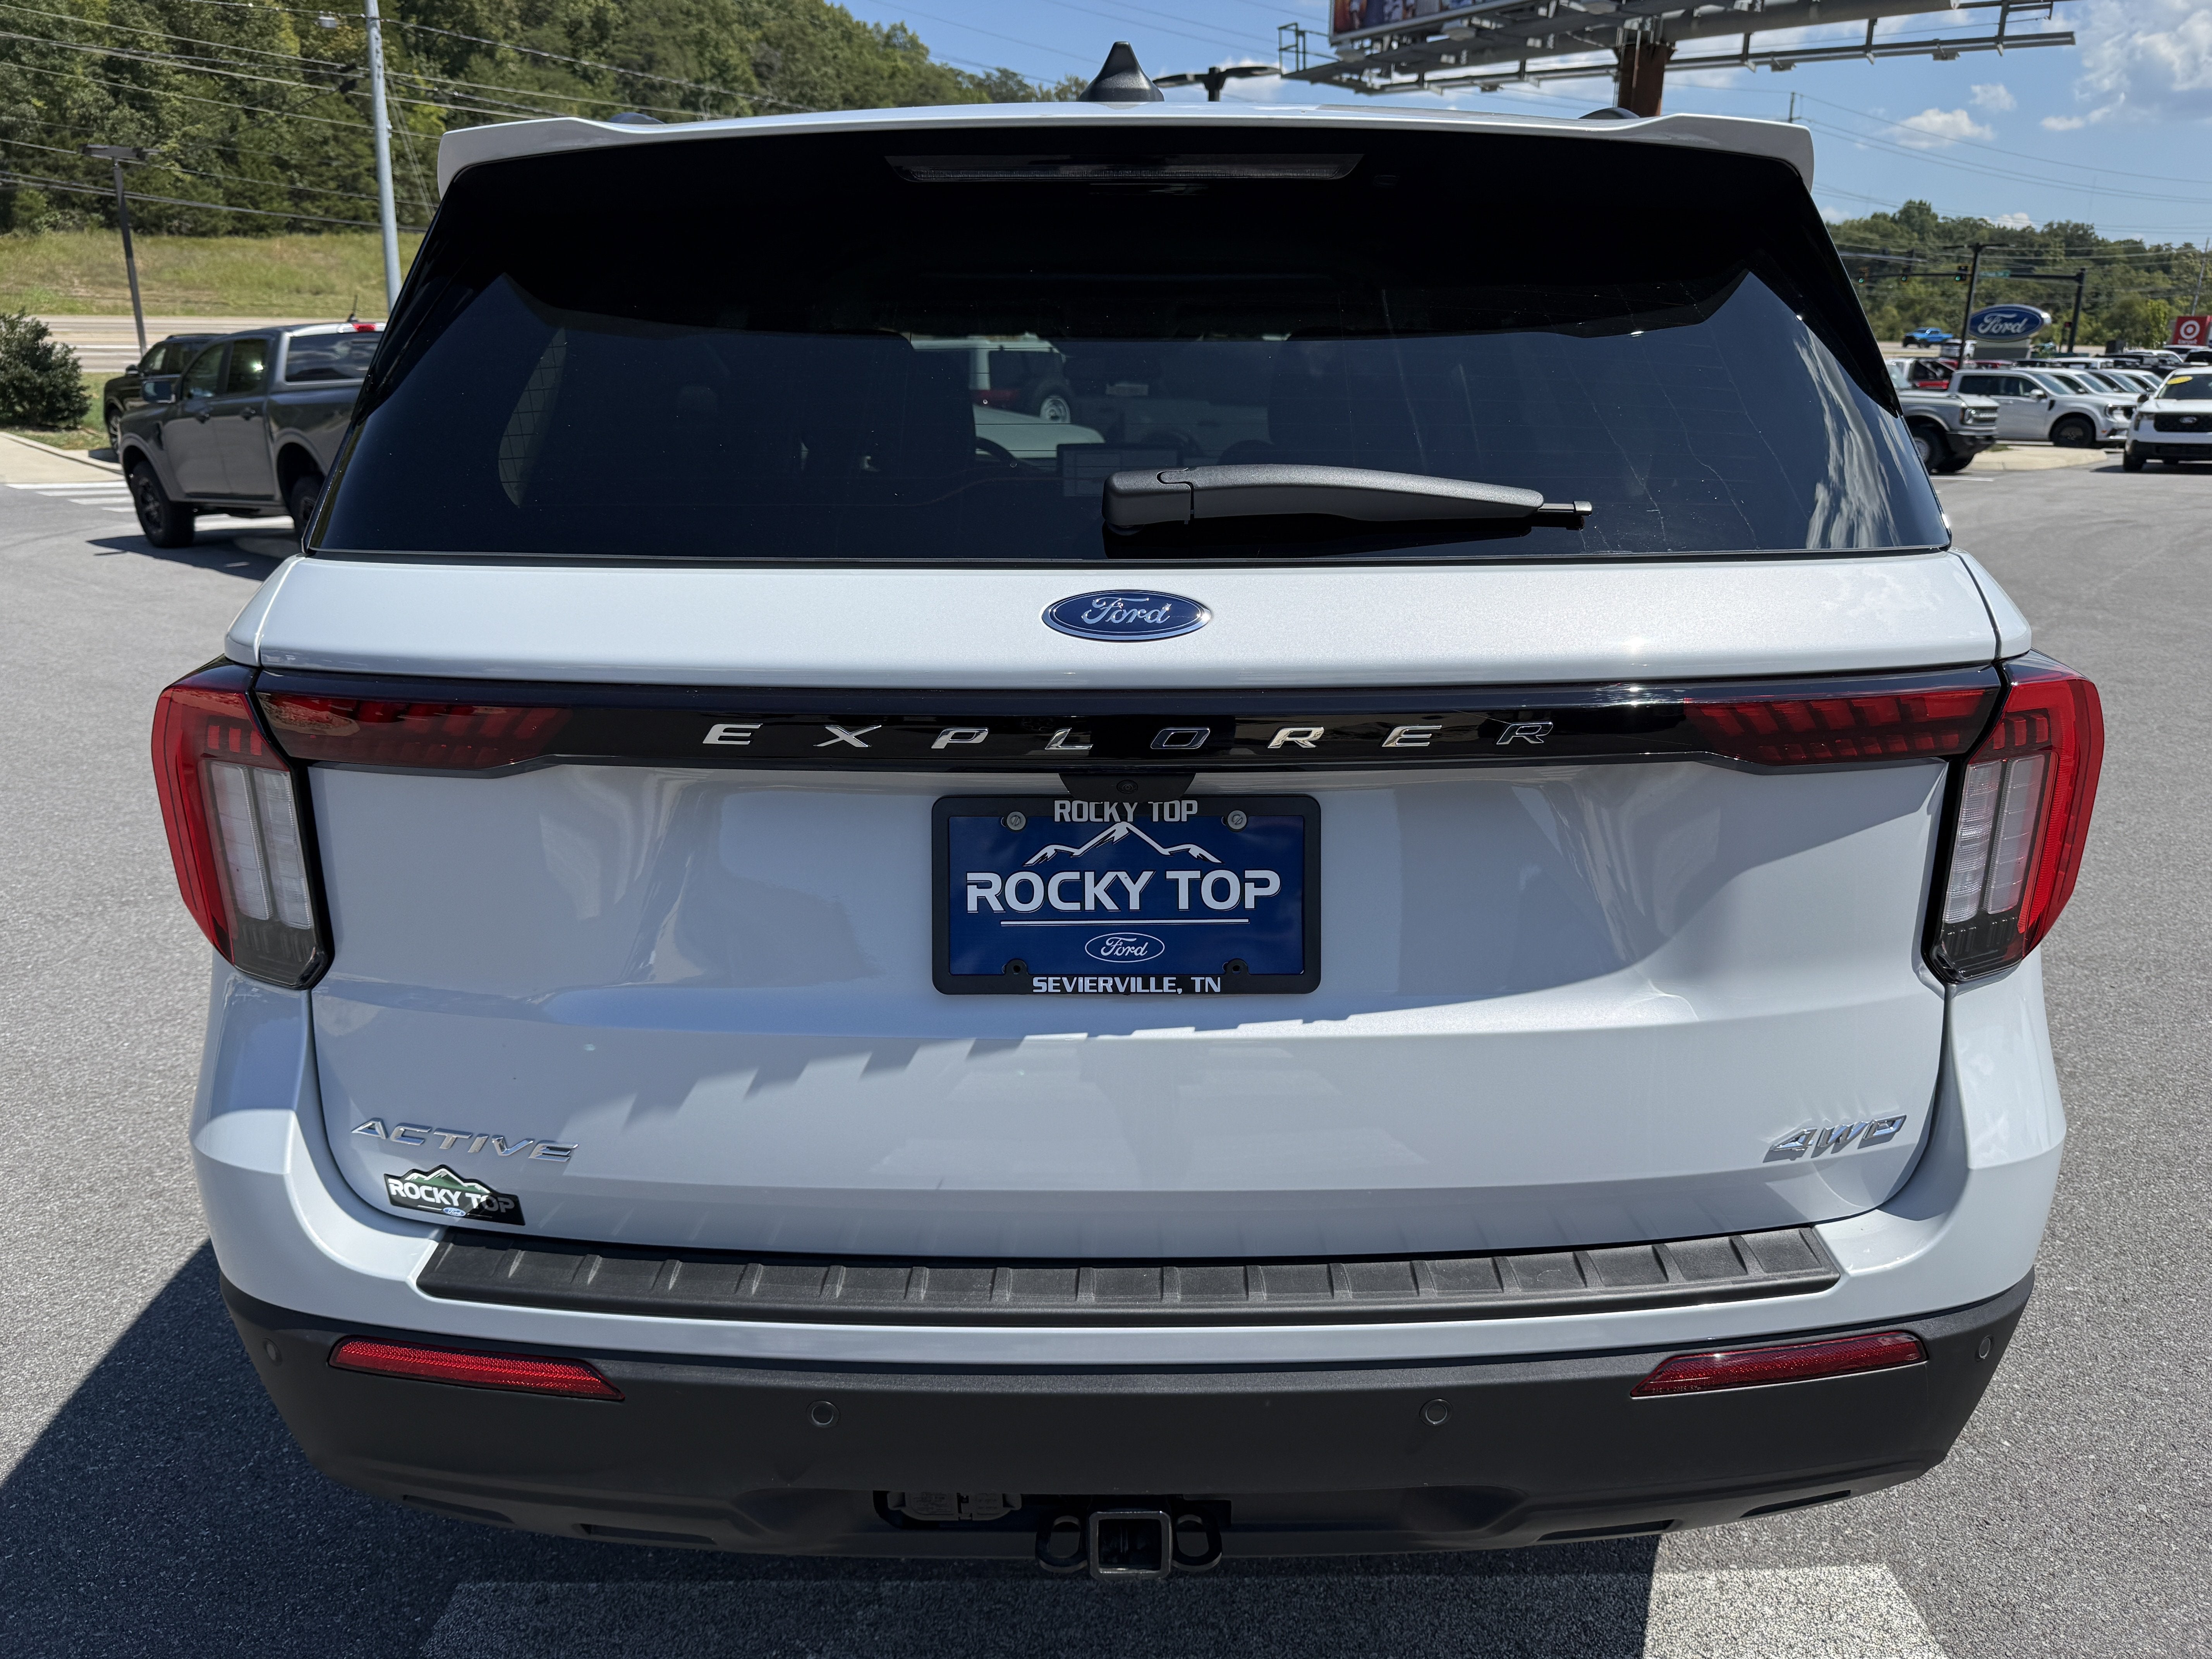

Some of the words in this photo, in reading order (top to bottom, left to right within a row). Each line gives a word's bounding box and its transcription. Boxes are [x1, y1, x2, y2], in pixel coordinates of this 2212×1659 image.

[1977, 313, 2029, 334] Ford
[1082, 597, 1172, 624] Ford
[702, 721, 1553, 751] EXPLORER
[1054, 800, 1138, 822] ROCKY
[1148, 800, 1197, 822] TOP
[967, 871, 1155, 913] ROCKY
[1166, 870, 1281, 911] TOP
[1101, 937, 1148, 957] Ford
[1033, 977, 1182, 994] SEVIERVILLE,
[1191, 977, 1221, 993] TN
[351, 1117, 579, 1162] ACTIVE
[1770, 1114, 1907, 1151] 4WD
[388, 1178, 462, 1206] ROCKY
[465, 1192, 515, 1213] TOP
